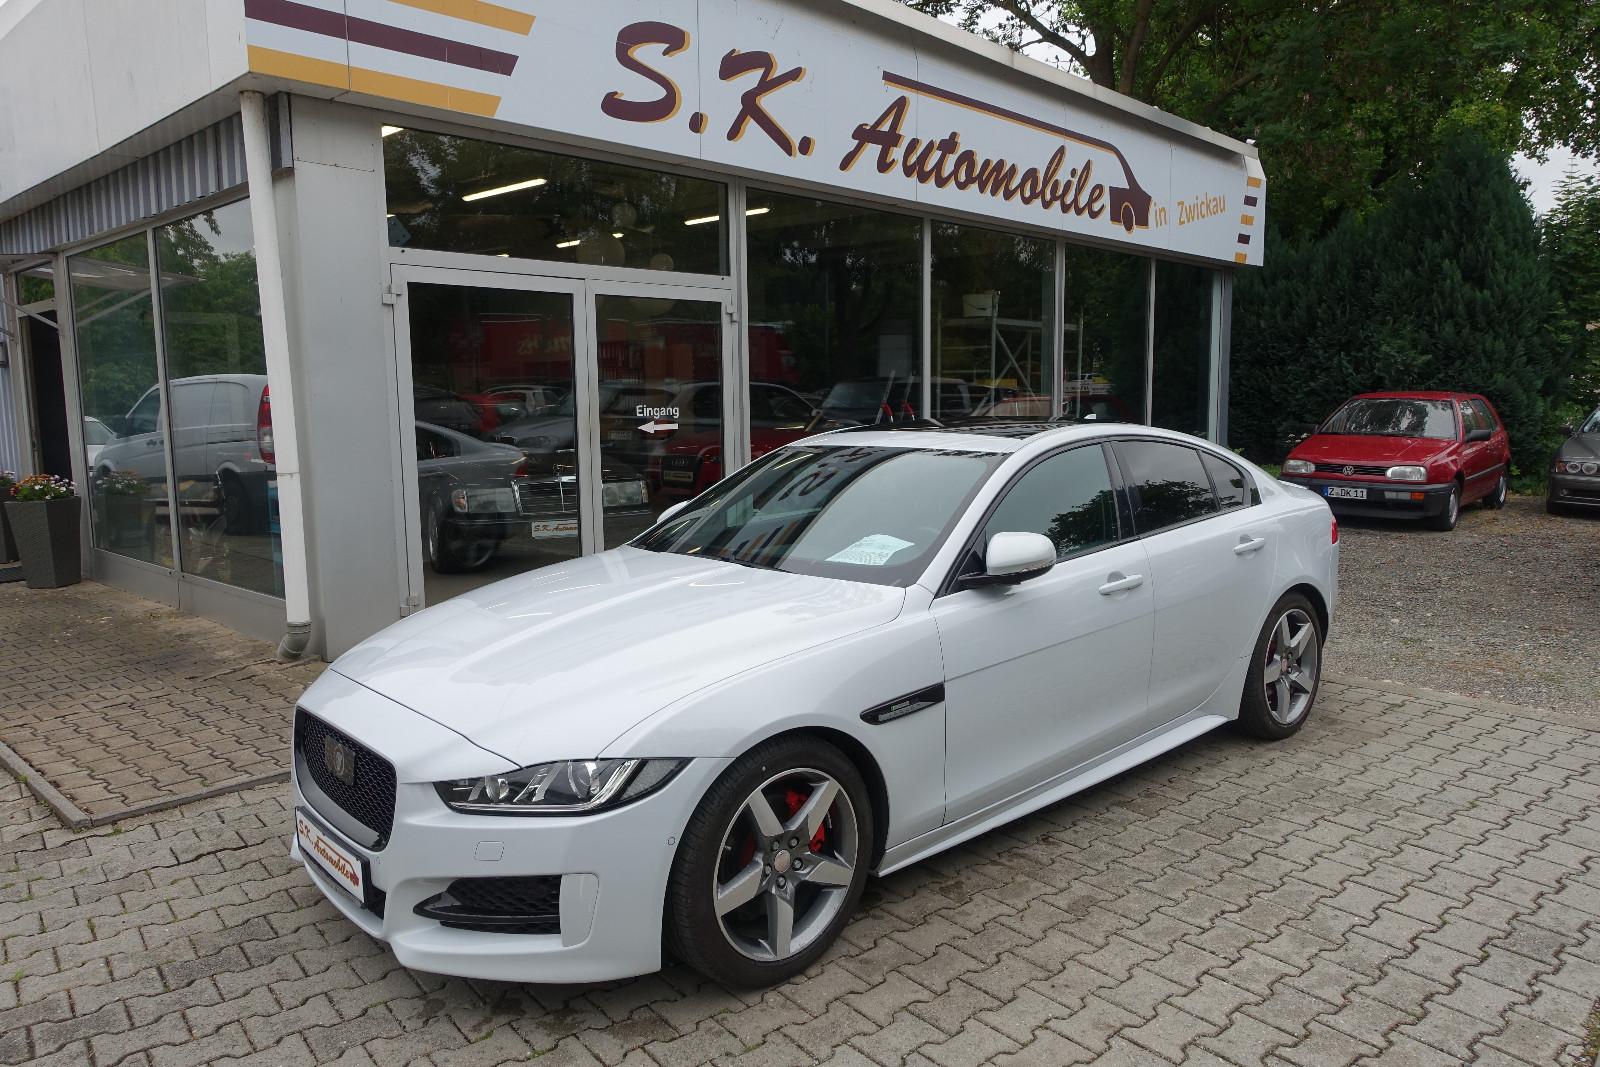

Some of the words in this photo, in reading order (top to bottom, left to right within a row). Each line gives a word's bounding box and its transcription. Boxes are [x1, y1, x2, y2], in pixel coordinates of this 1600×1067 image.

[838, 95, 1106, 220] Automobile
[1153, 202, 1168, 228] in
[1177, 191, 1226, 226] Zwickau
[636, 404, 679, 419] Eingang
